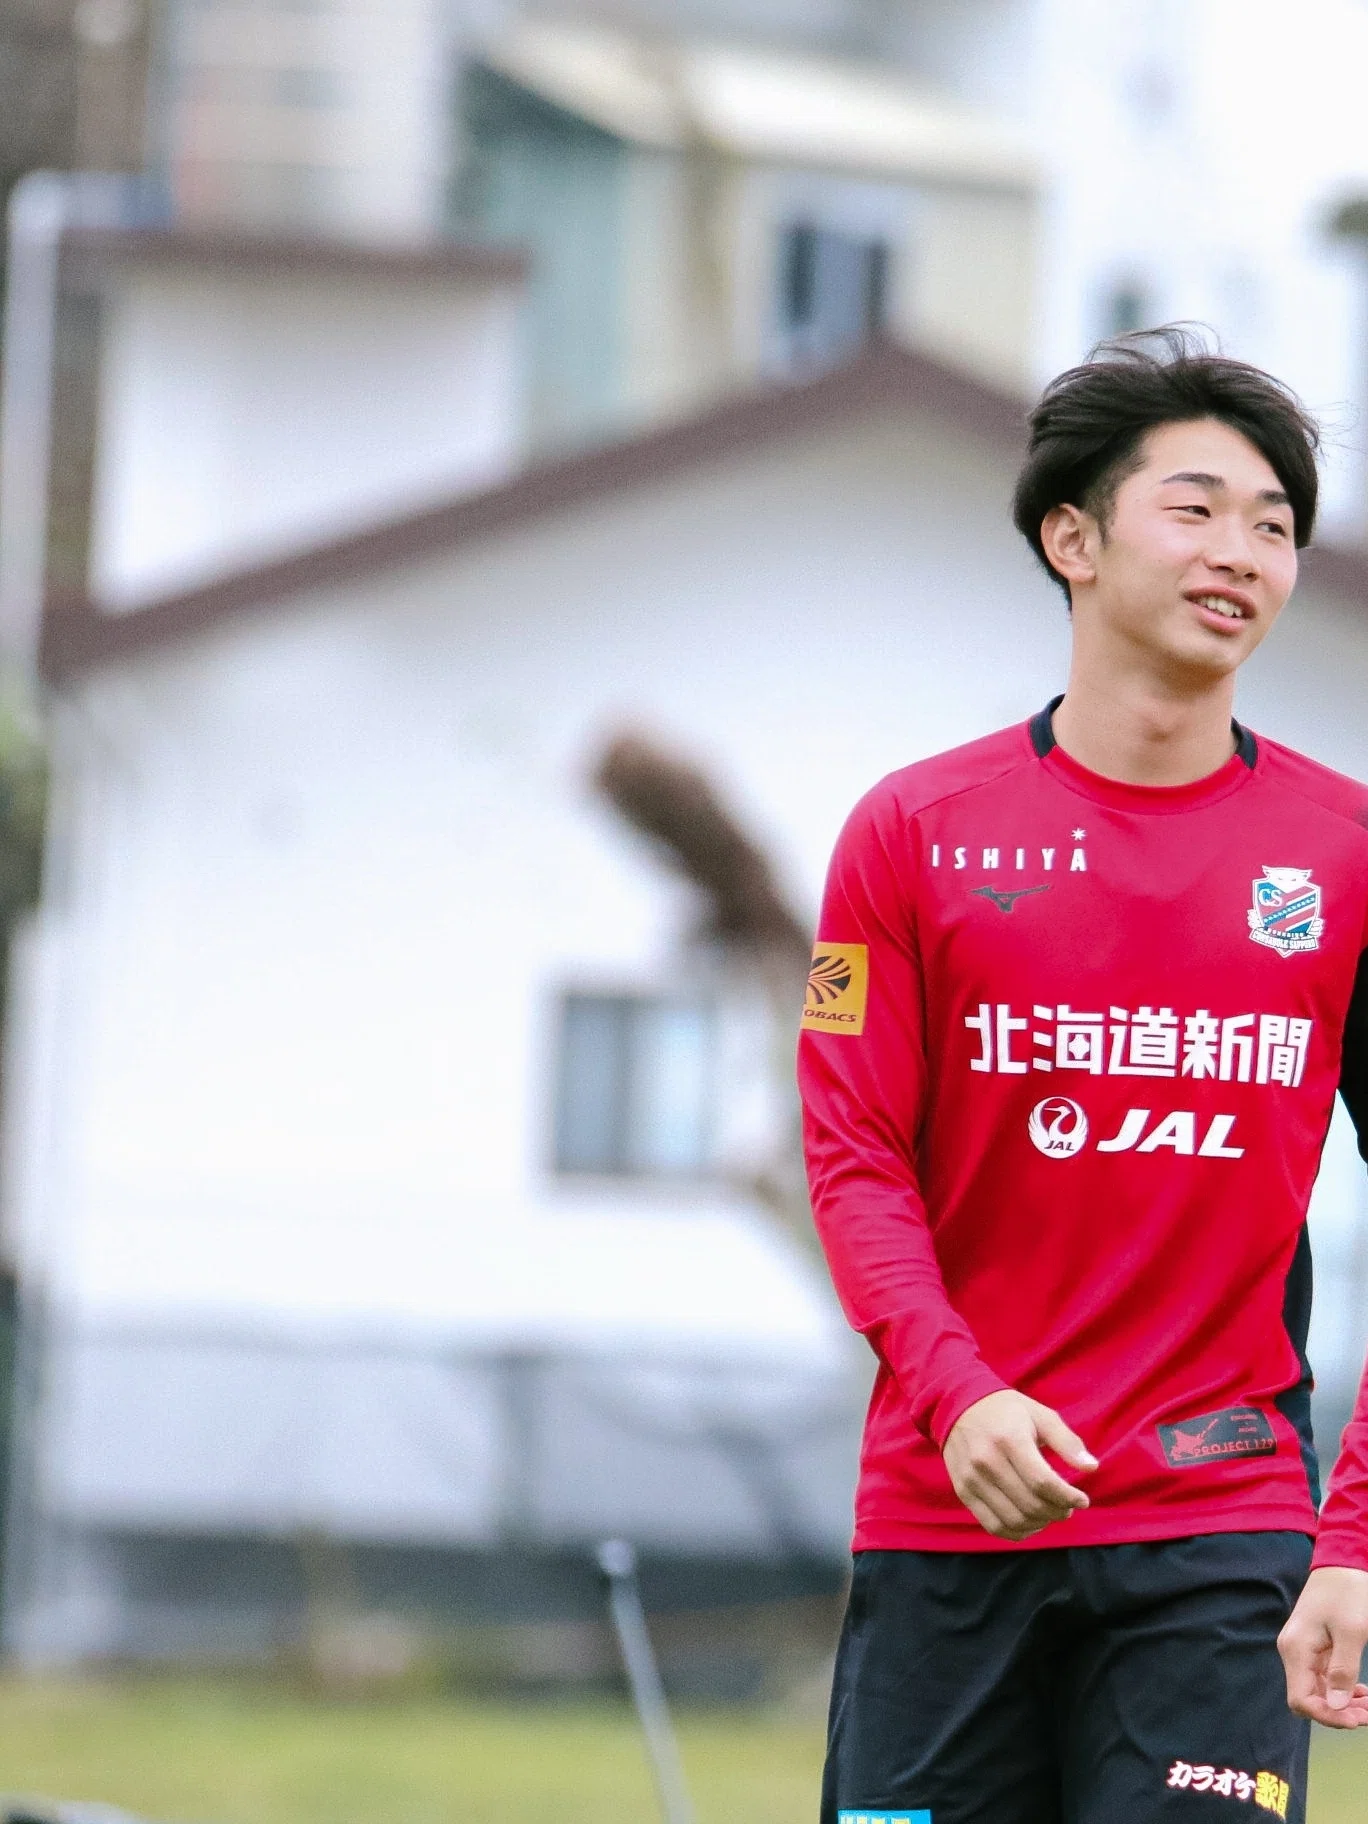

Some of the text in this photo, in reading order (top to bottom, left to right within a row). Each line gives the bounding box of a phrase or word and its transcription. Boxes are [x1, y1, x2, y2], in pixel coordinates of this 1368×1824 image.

[931, 844, 1087, 872] ISHIYA
[1259, 888, 1282, 907] CS
[964, 1003, 1313, 1089] 北海道新聞
[1096, 1108, 1246, 1159] JAL
[1043, 1139, 1075, 1152] JAL
[1193, 1441, 1249, 1457] PROJECT
